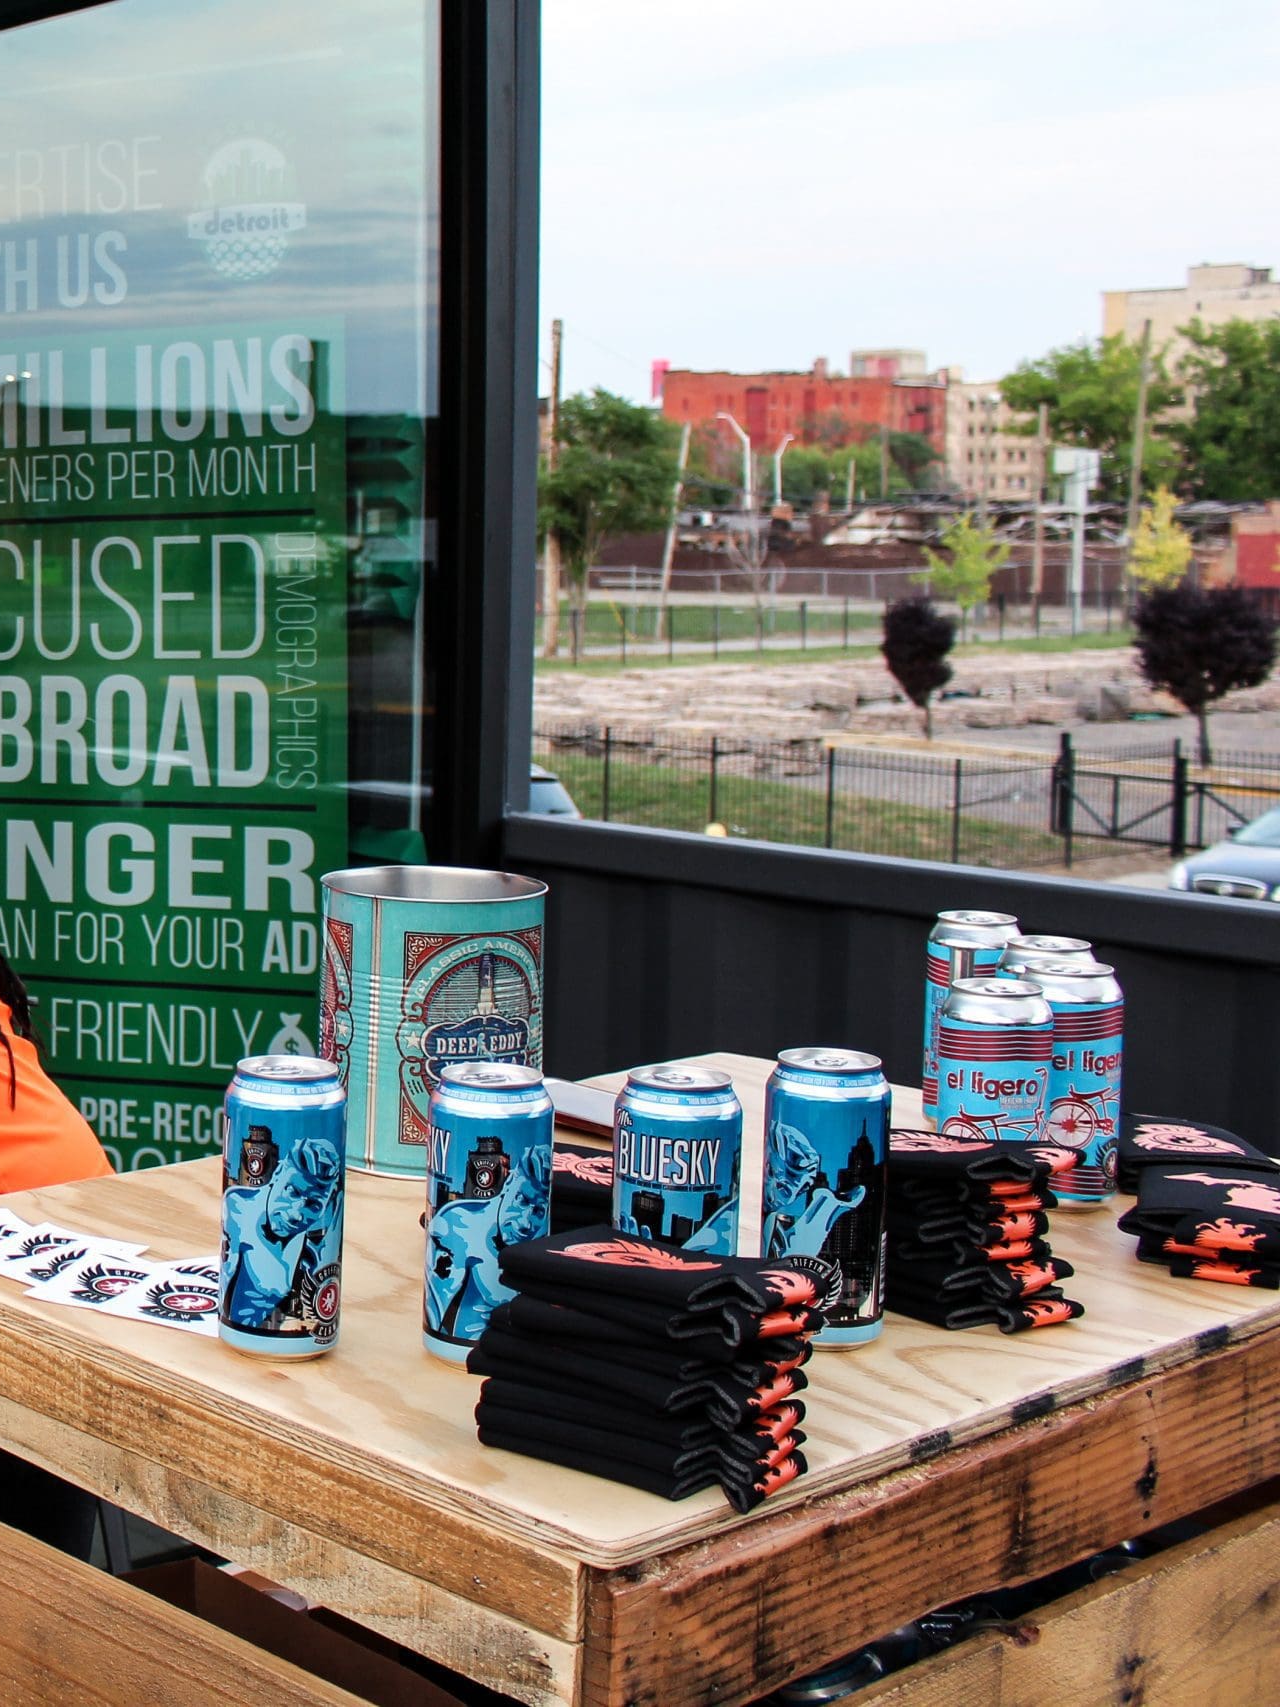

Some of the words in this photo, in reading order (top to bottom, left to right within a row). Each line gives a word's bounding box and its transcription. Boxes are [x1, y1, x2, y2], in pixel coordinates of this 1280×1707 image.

[204, 207, 291, 236] detroit
[56, 230, 129, 308] US
[107, 450, 176, 501] PER
[188, 443, 317, 497] MONTH
[275, 531, 319, 790] DEMOGRAPHICS
[54, 911, 125, 966] FOR
[142, 914, 245, 971] YOUR
[262, 920, 317, 976] AD
[415, 943, 480, 998] CLASSIC
[50, 996, 264, 1071] FRIENDLY
[436, 1037, 478, 1054] DEEP
[489, 1031, 524, 1052] EDDY
[947, 1069, 964, 1090] el
[971, 1071, 1039, 1101] ligero
[1052, 1051, 1075, 1072] el
[1082, 1050, 1121, 1077] liger
[618, 1128, 721, 1186] BLUESKY
